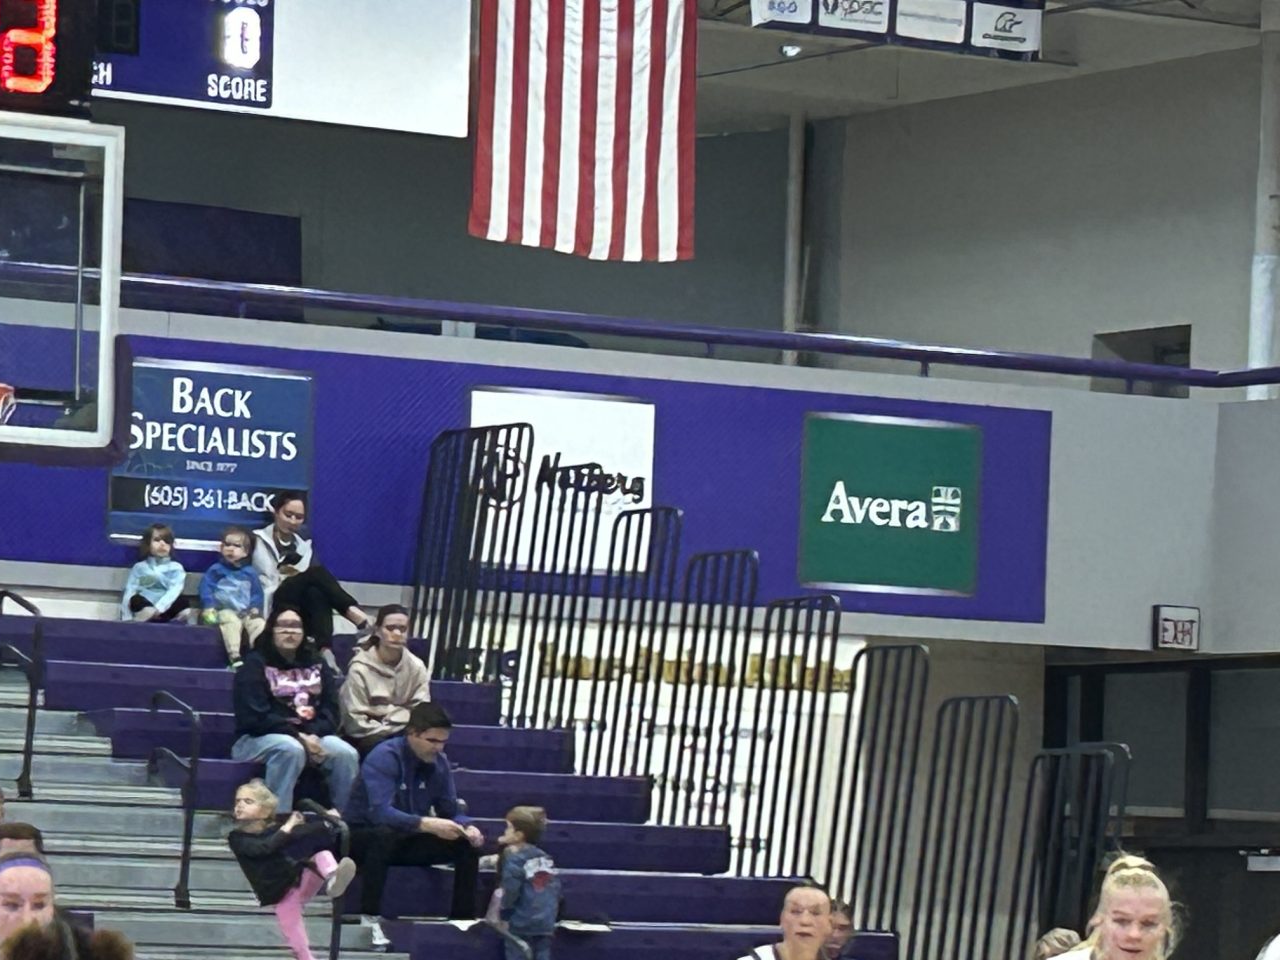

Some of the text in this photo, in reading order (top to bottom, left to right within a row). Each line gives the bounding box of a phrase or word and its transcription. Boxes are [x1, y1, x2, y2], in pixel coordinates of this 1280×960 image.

[207, 73, 267, 102] SCORE
[172, 377, 252, 419] BACK
[129, 412, 298, 461] SPECIALISTS
[144, 484, 276, 513] (605) 361-BACK
[821, 480, 929, 529] Avera
